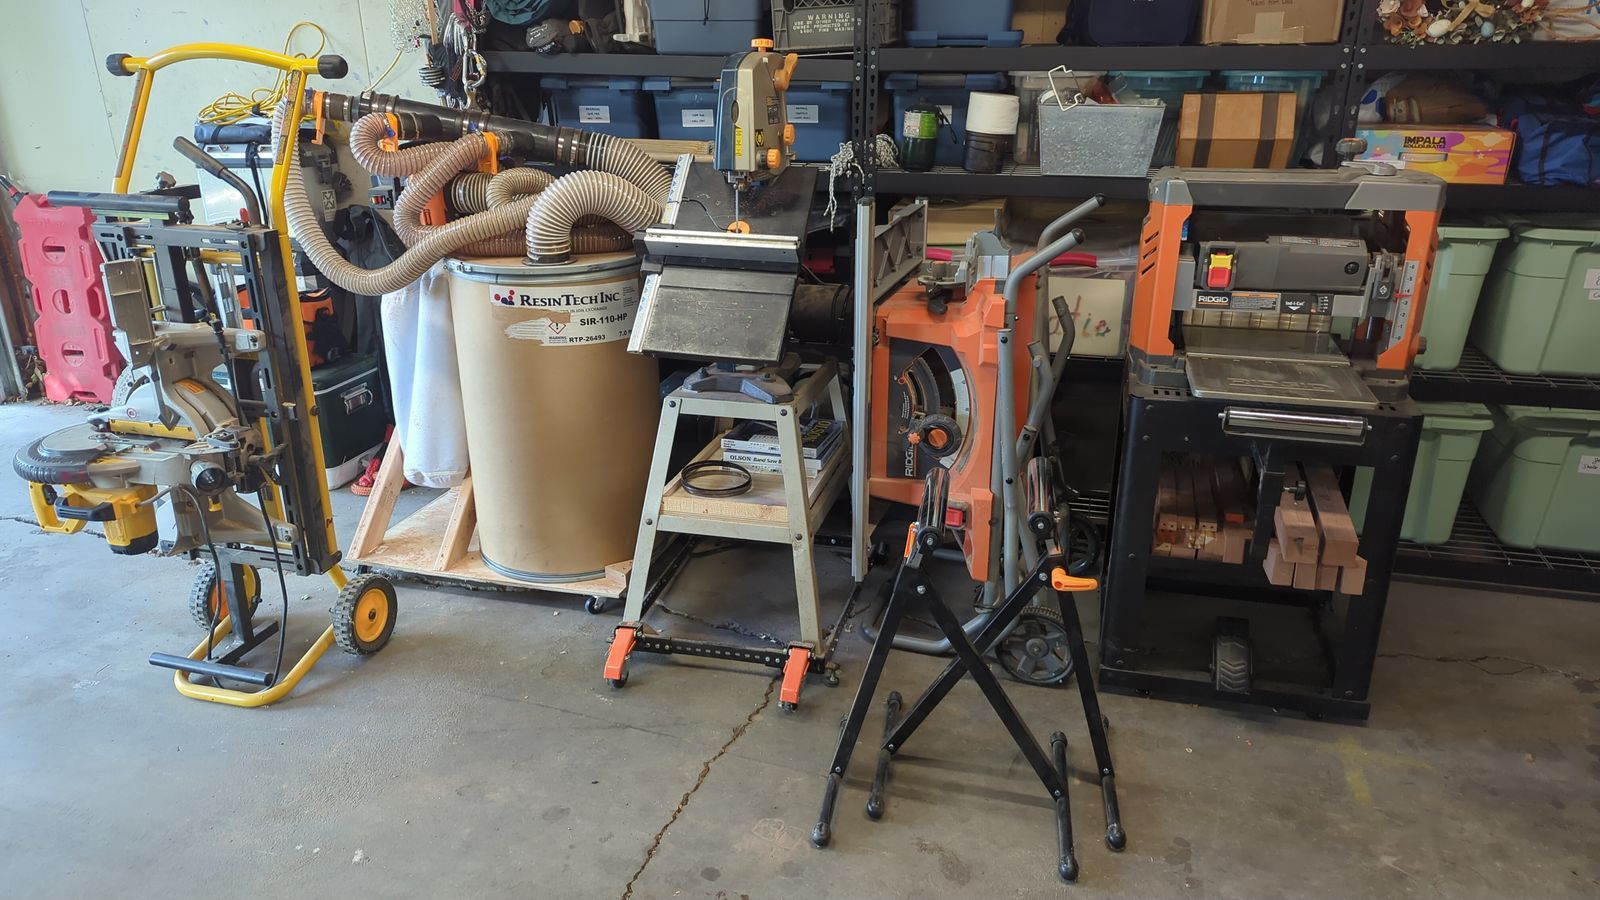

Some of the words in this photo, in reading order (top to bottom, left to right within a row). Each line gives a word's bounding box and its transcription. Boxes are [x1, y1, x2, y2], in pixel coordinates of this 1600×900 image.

[808, 12, 850, 20] WARNING
[1404, 136, 1446, 145] IMPALA
[1198, 295, 1229, 303] RIDGID
[580, 313, 628, 326] SIR-110-HP
[569, 334, 606, 343] RTP-26493
[730, 454, 752, 462] OLSON
[905, 444, 914, 477] RIDGI
